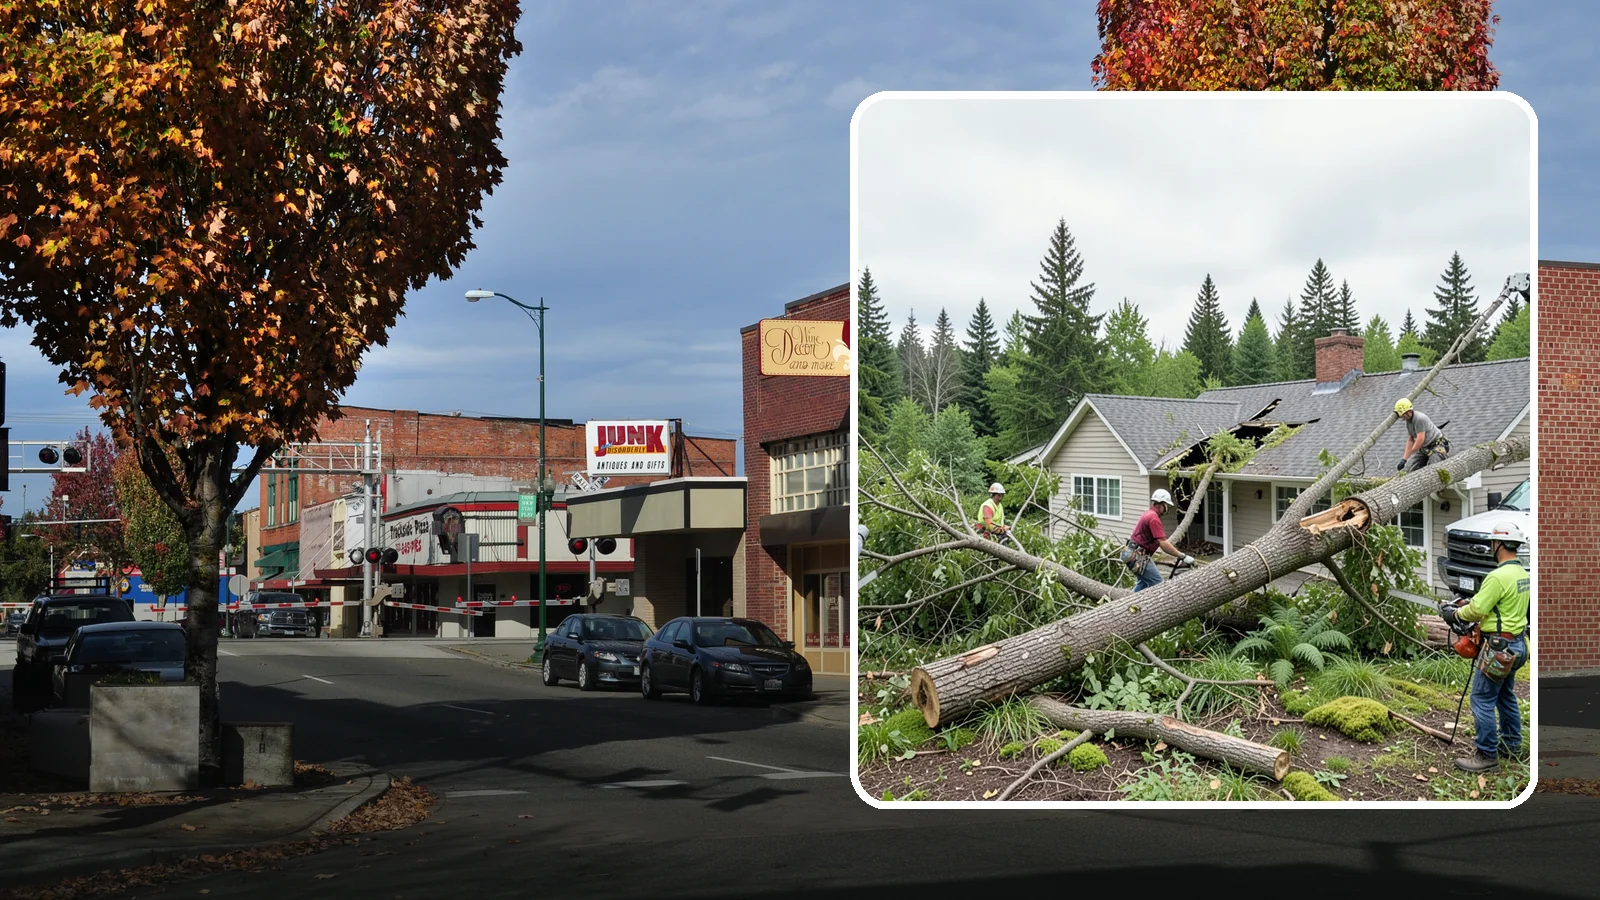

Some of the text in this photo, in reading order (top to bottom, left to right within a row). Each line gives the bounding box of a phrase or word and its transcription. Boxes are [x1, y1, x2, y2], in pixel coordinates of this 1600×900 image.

[595, 425, 665, 457] JUNK
[607, 446, 646, 454] DISORDERLY
[597, 460, 665, 470] ANTIQUES AND GIFTS
[414, 519, 429, 535] Pizza
